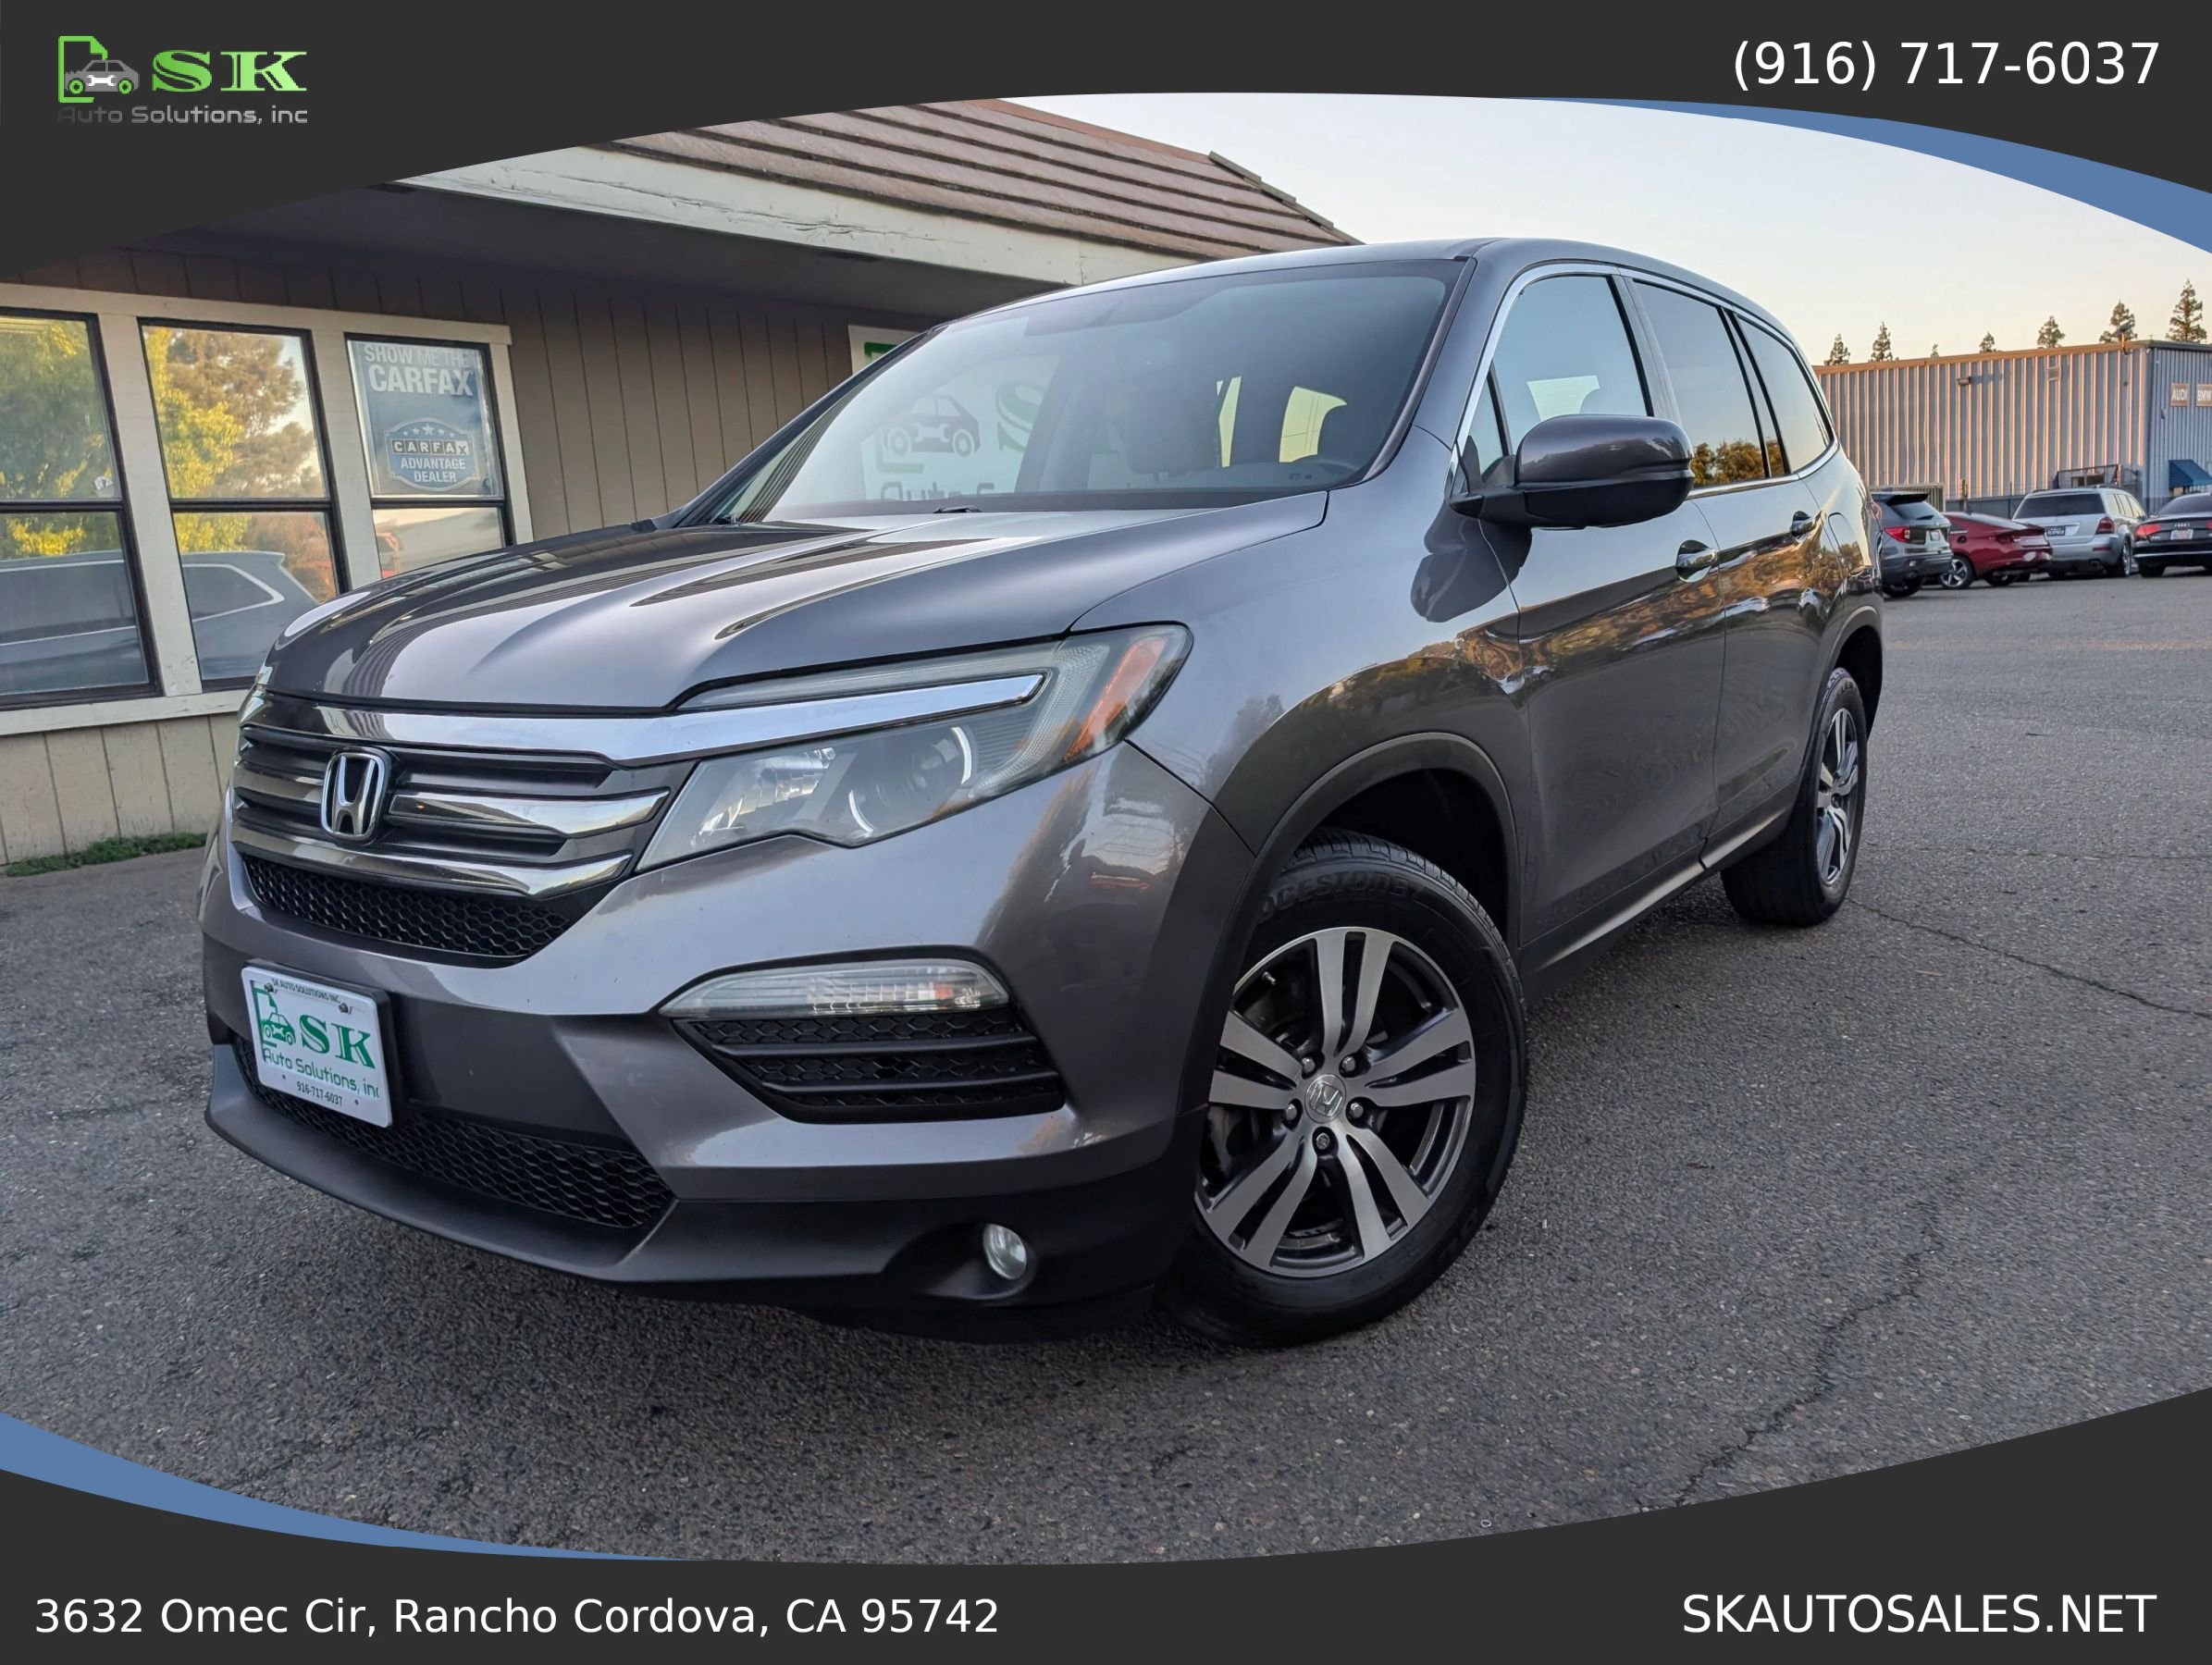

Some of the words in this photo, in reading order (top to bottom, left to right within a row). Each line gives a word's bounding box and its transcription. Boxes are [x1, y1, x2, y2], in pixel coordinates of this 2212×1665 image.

[364, 343, 413, 364] SHOW
[418, 349, 440, 366] ME
[444, 351, 470, 368] THE
[368, 364, 474, 396] CARFAX
[392, 440, 467, 455] CARFAX
[401, 457, 466, 470] ADVANTAGE
[414, 470, 457, 483] DEALER
[300, 1014, 376, 1069] SK
[263, 1048, 293, 1069] Auto
[296, 1057, 361, 1095] Solutions,
[296, 1080, 343, 1107] 916-717-6037
